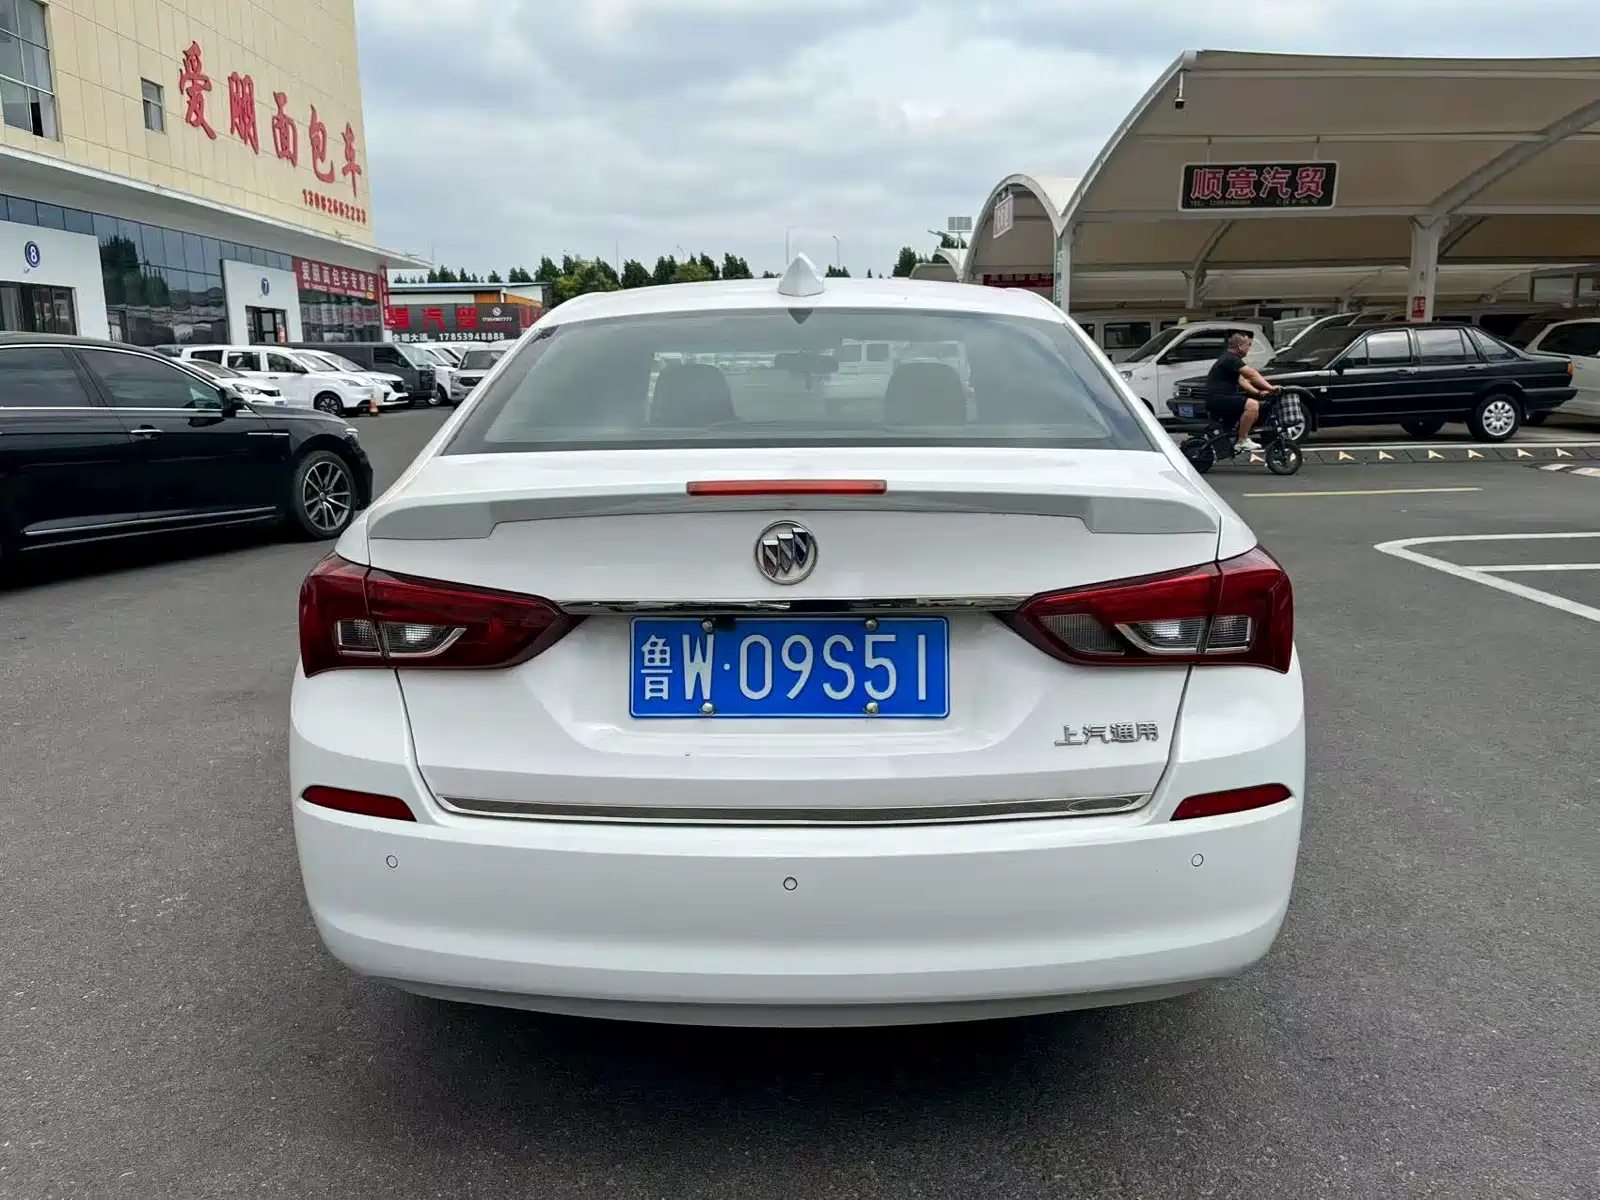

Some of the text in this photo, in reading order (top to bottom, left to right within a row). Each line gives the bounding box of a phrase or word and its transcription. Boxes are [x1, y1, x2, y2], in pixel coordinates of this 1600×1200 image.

[1190, 167, 1326, 199] 顺意汽贸
[439, 332, 505, 341] 17853948888
[1054, 722, 1159, 747] 上汽通用
